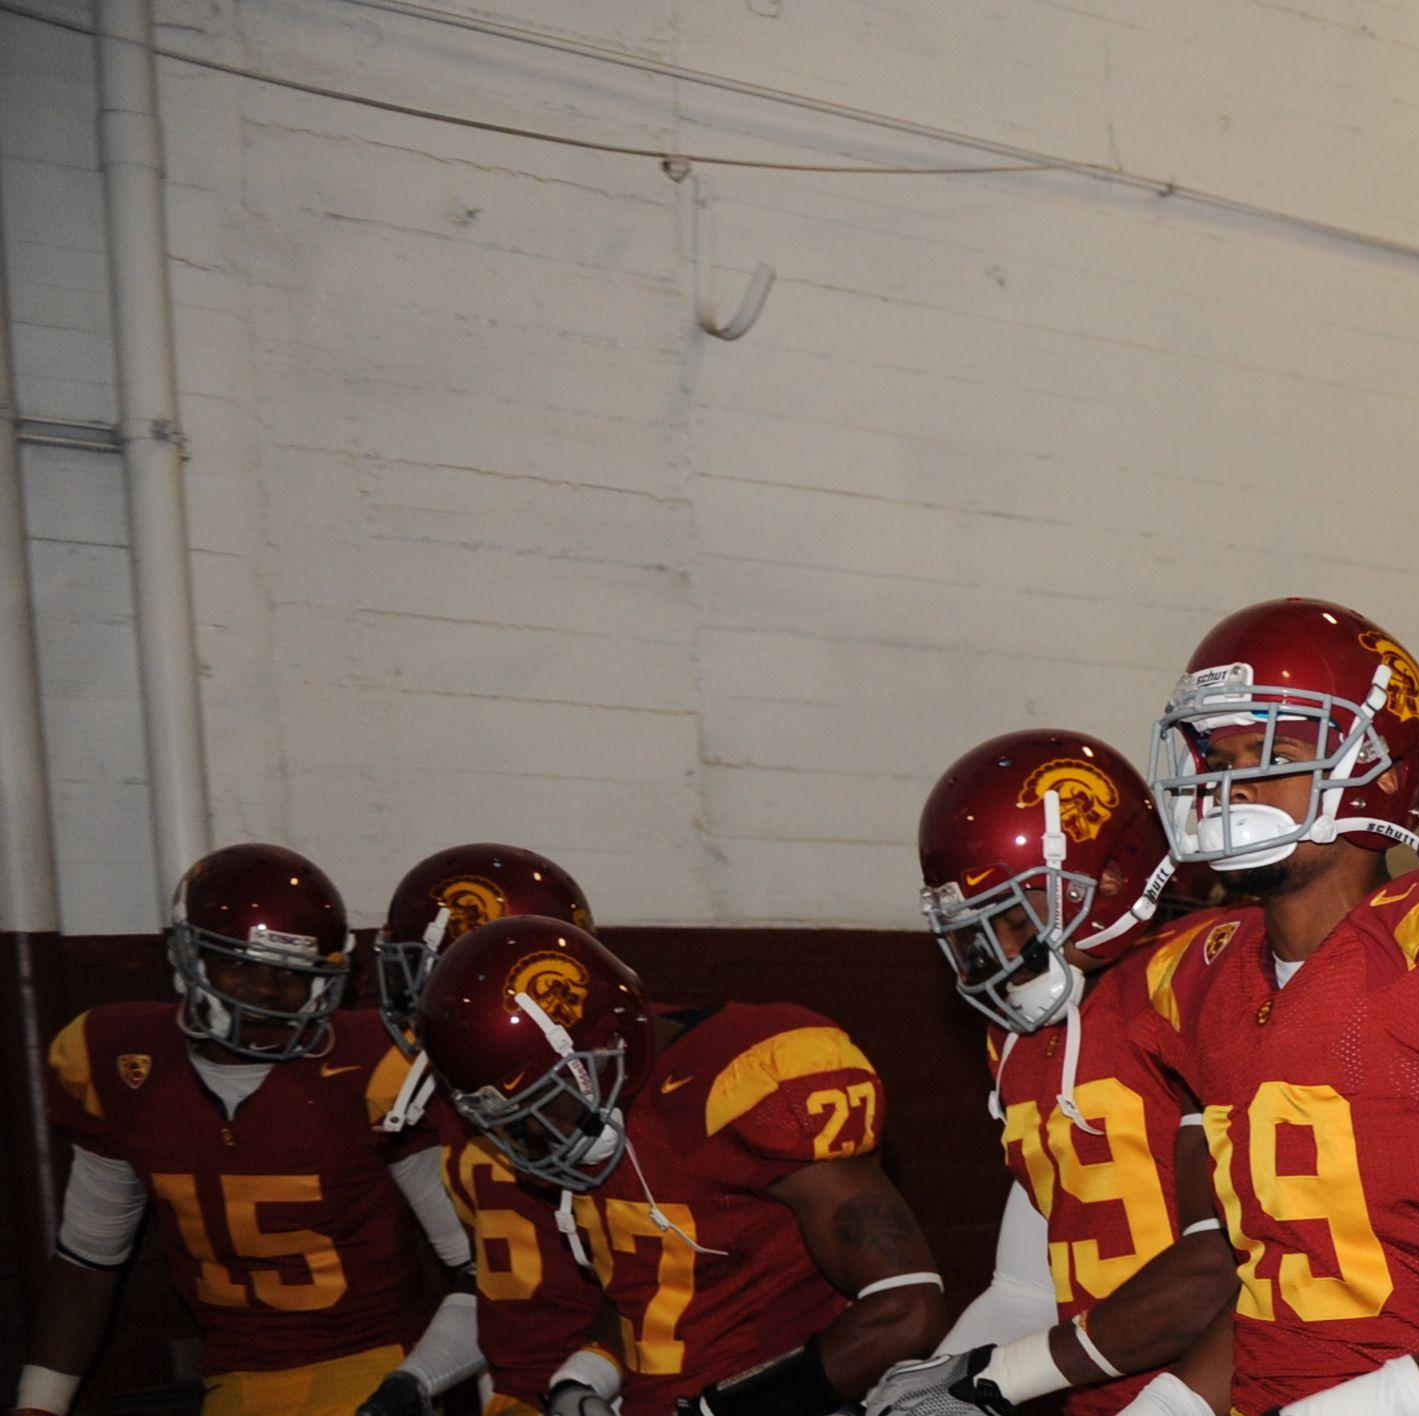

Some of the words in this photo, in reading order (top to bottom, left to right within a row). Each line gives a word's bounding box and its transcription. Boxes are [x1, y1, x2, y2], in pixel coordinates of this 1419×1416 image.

[1366, 823, 1416, 846] schutt
[805, 1081, 878, 1161] 27
[151, 1172, 349, 1312] 15
[441, 1140, 544, 1301] 6
[1203, 1080, 1394, 1323] 19
